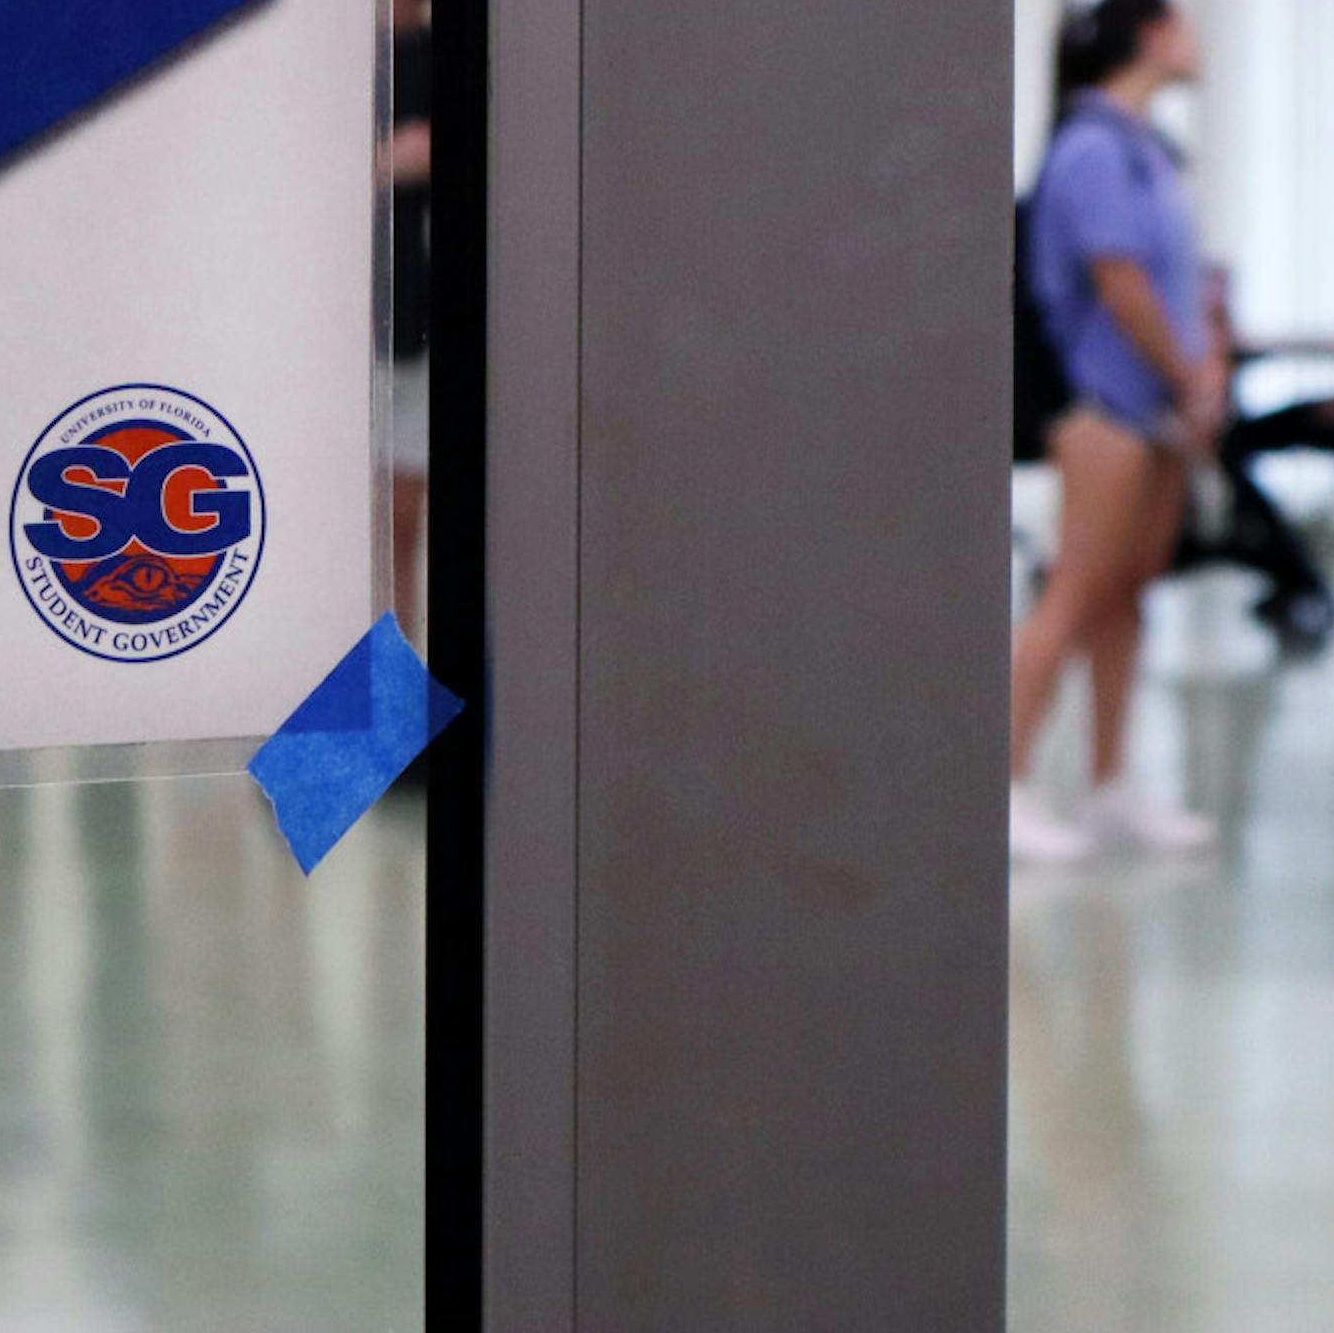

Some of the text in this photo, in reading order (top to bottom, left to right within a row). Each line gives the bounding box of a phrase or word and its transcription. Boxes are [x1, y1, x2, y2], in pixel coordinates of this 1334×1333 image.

[60, 398, 212, 445] UNIVERSITY OF FLORIDA
[23, 441, 251, 561] SG
[25, 548, 249, 653] STUDENT GOVERNMENT
